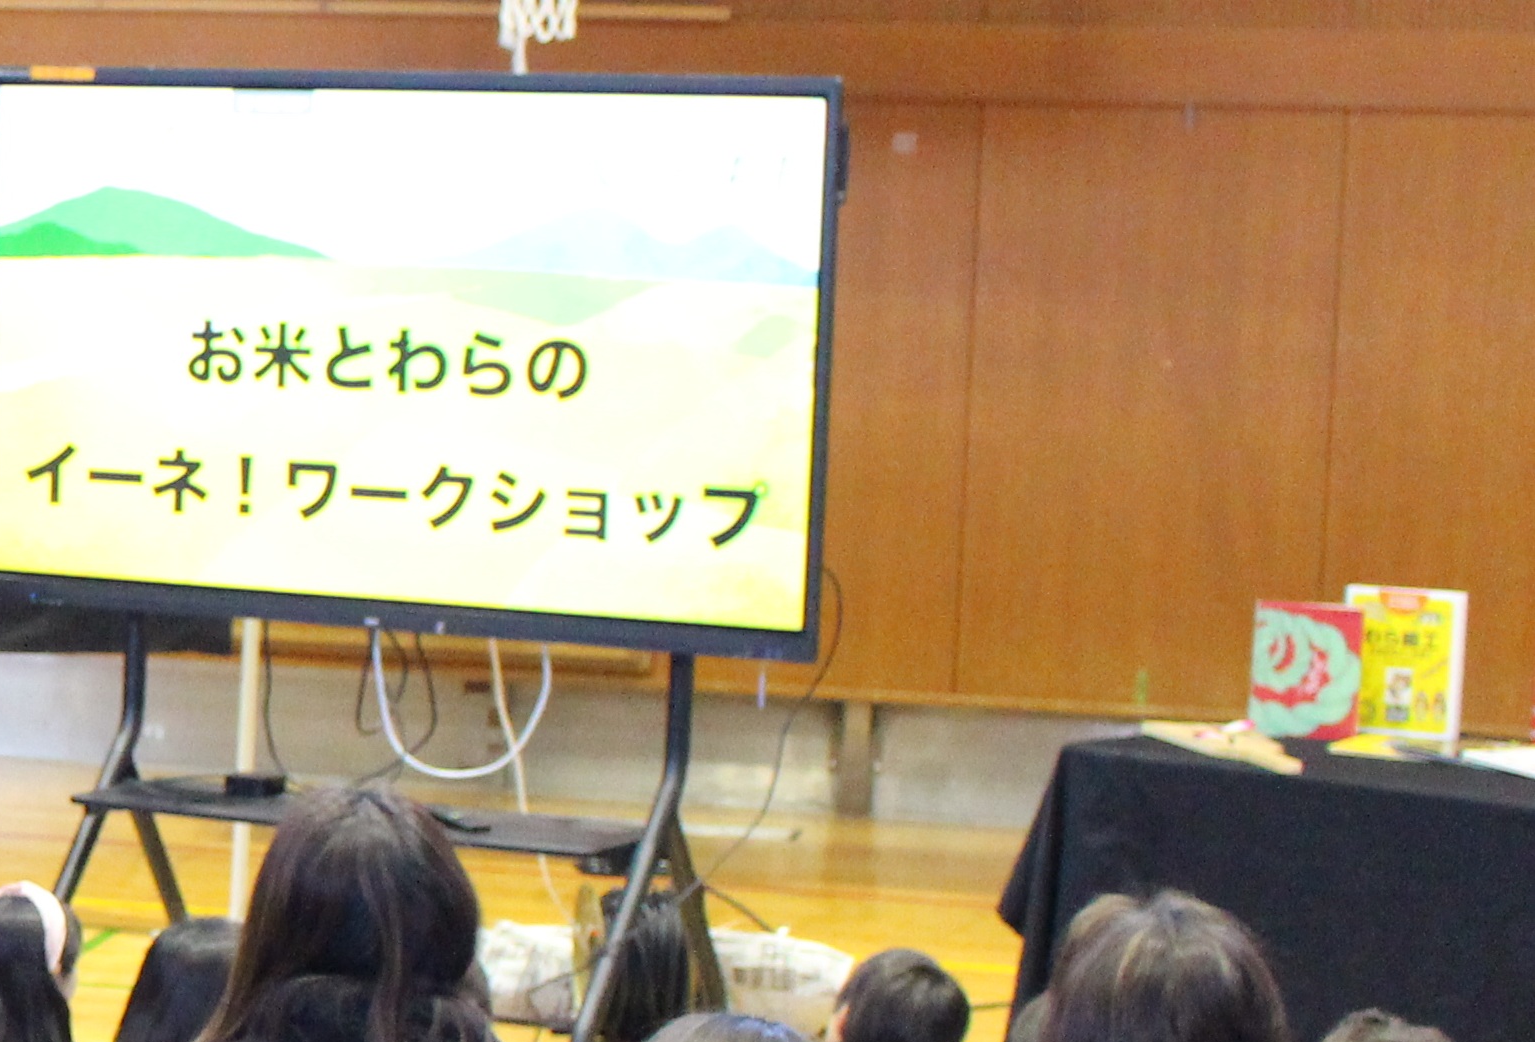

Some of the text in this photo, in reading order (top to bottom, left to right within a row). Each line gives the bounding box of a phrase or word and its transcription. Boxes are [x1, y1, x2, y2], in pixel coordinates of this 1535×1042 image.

[188, 320, 589, 399] お米とわらの
[26, 445, 769, 548] イーネ！ワークショップ
